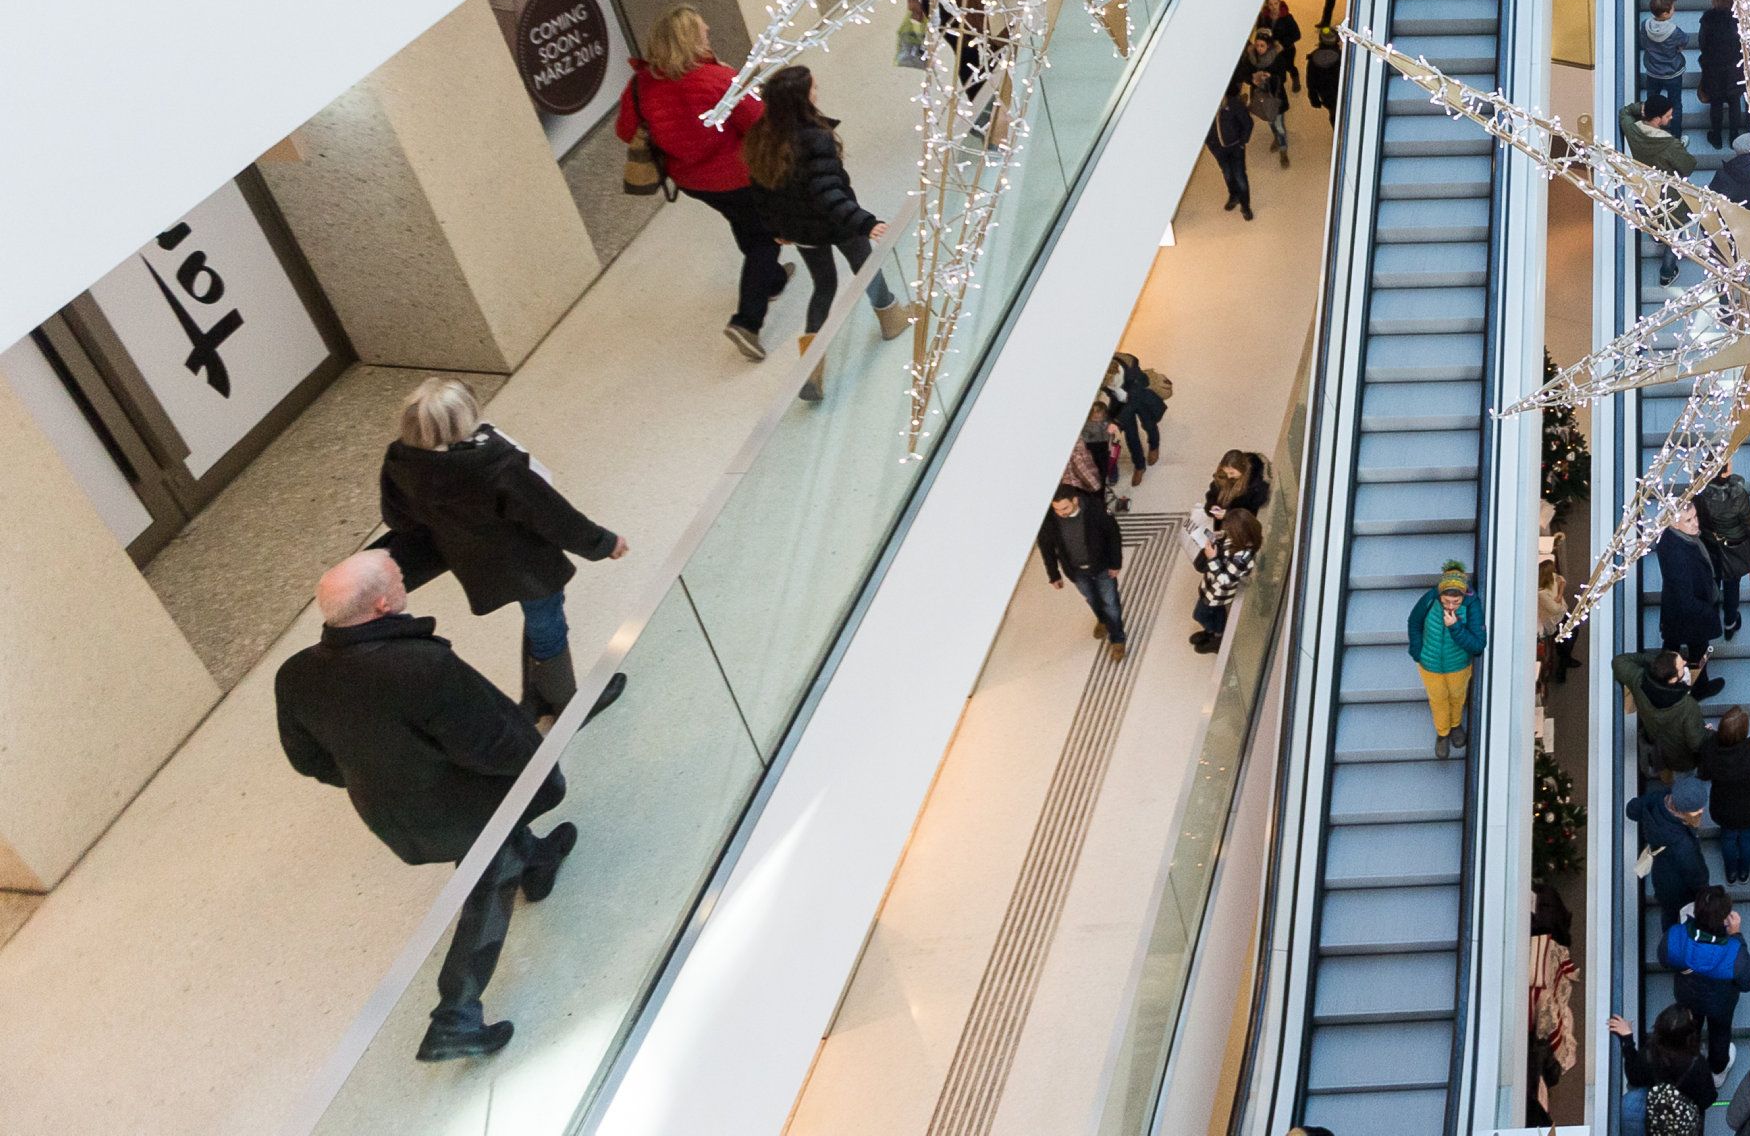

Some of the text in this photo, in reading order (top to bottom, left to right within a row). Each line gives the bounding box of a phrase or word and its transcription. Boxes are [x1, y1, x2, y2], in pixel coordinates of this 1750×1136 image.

[529, 3, 588, 44] COMING
[538, 29, 580, 64] SOON
[573, 40, 604, 67] 2016
